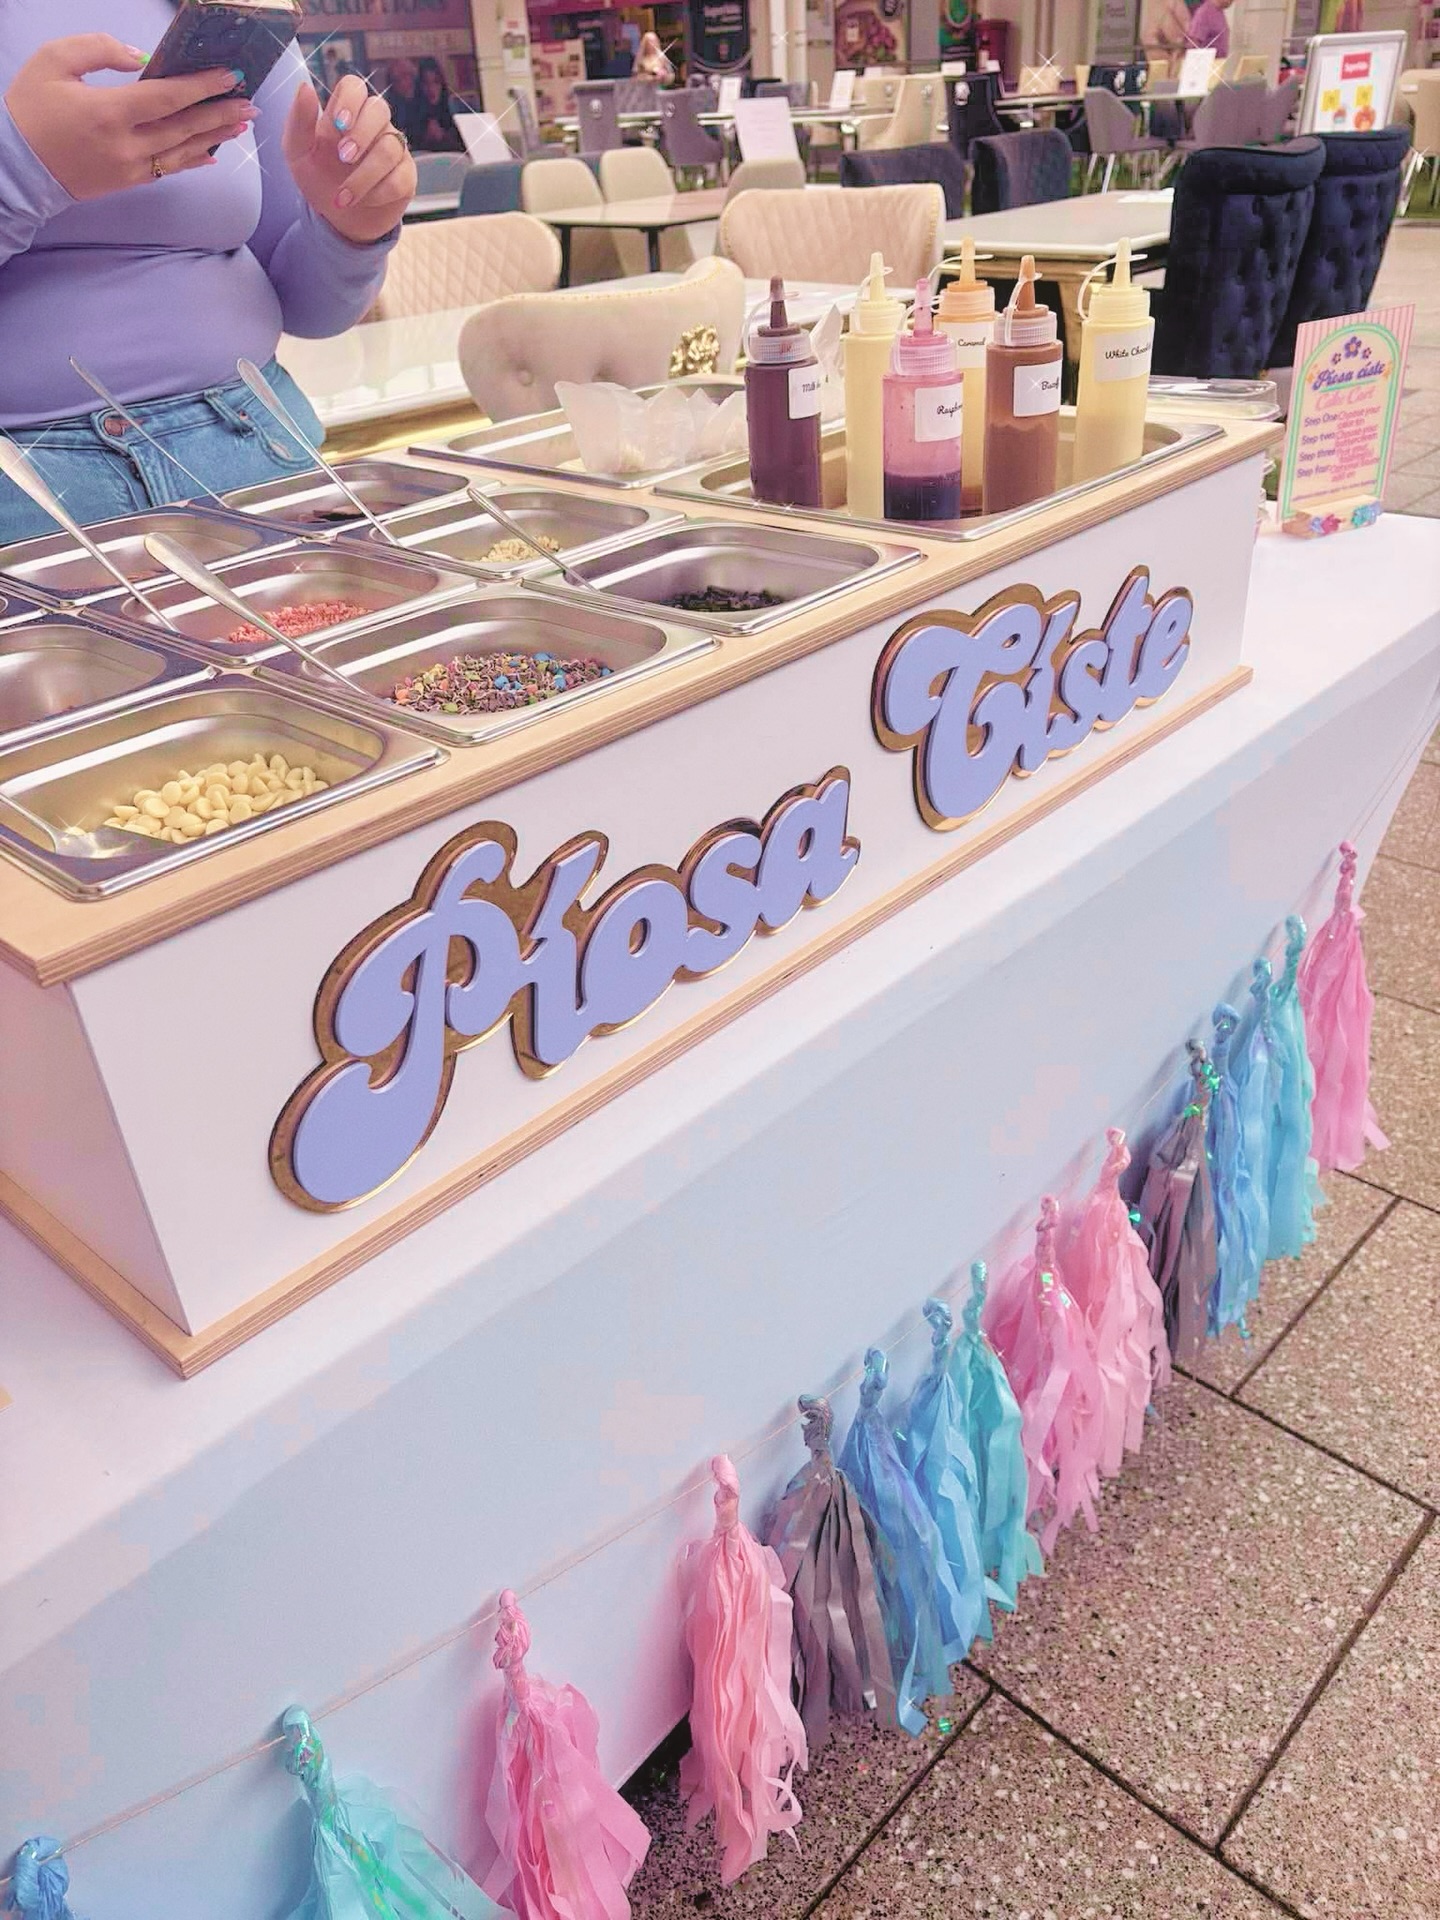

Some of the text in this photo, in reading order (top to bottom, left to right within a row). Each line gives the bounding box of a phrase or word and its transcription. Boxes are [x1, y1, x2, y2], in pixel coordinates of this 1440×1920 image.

[1105, 349, 1129, 359] White
[1304, 417, 1321, 427] Step
[1302, 435, 1319, 445] Step
[1299, 452, 1316, 462] Step
[1297, 468, 1314, 478] Step
